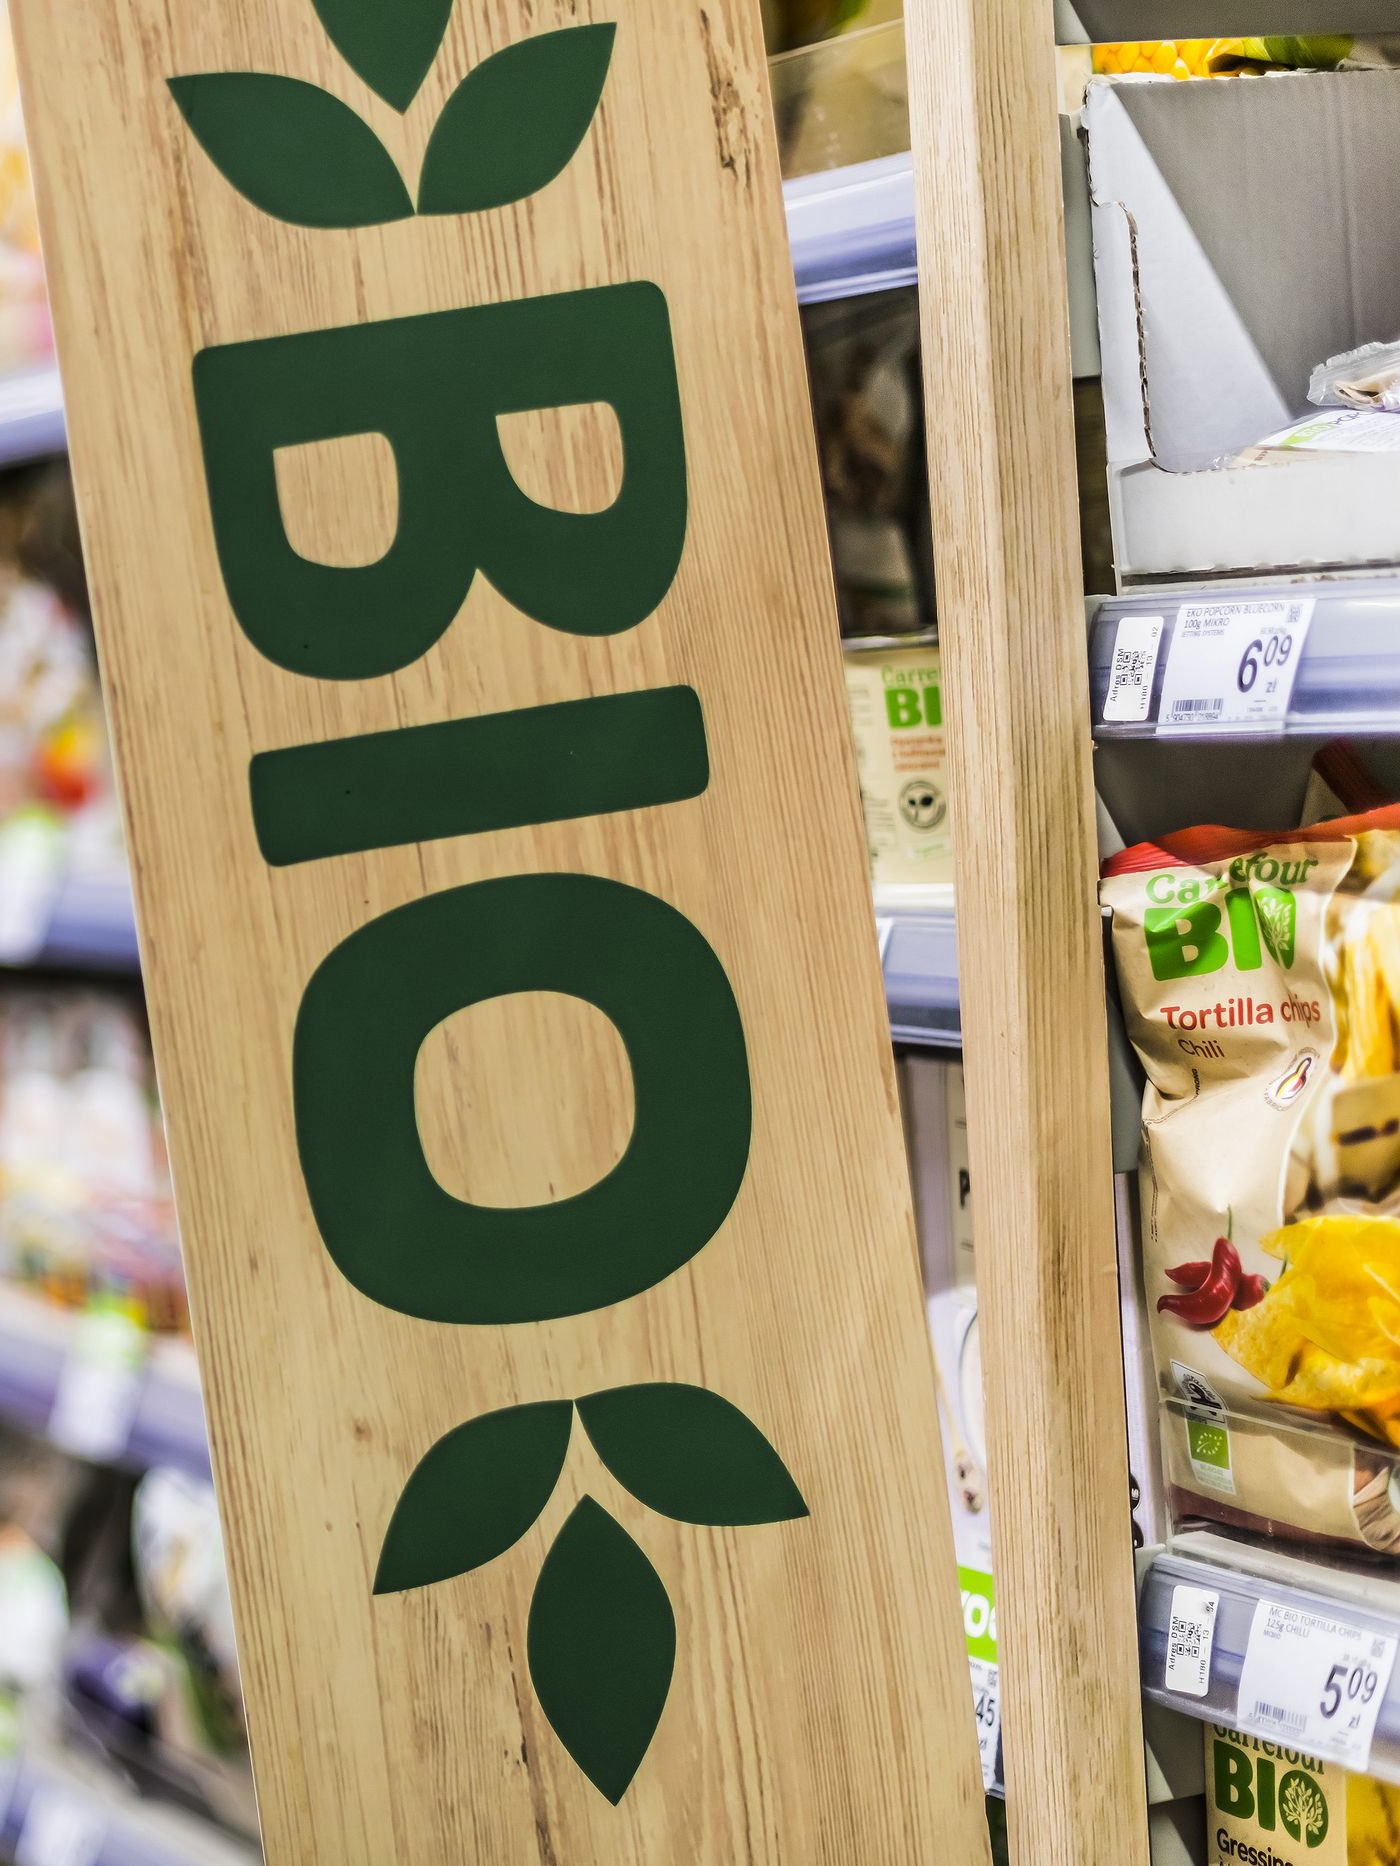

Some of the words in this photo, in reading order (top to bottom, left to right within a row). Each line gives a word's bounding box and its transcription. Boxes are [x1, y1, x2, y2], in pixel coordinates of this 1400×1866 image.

[1186, 608, 1202, 618] EKO
[1203, 605, 1241, 617] POPCORN
[1183, 619, 1202, 630] 100g
[1203, 617, 1230, 628] MIKRO
[1115, 647, 1125, 671] DSM
[881, 664, 940, 685] Carre
[884, 685, 942, 729] BI
[191, 280, 752, 1325] BIO
[1160, 997, 1274, 1031] Tortilla
[1280, 993, 1321, 1028] chips
[1178, 1039, 1225, 1058] Chili
[1171, 1616, 1179, 1639] DSM
[1202, 1629, 1209, 1640] 13
[1266, 1617, 1285, 1633] 125g
[1285, 1623, 1311, 1639] CHILLI
[1269, 1607, 1283, 1618] MC
[1284, 1611, 1298, 1622] BIO
[1299, 1615, 1337, 1634] TORTILLA
[1338, 1627, 1363, 1641] CHIPS
[1168, 1643, 1178, 1670] Adres
[1212, 1739, 1329, 1849] BIO
